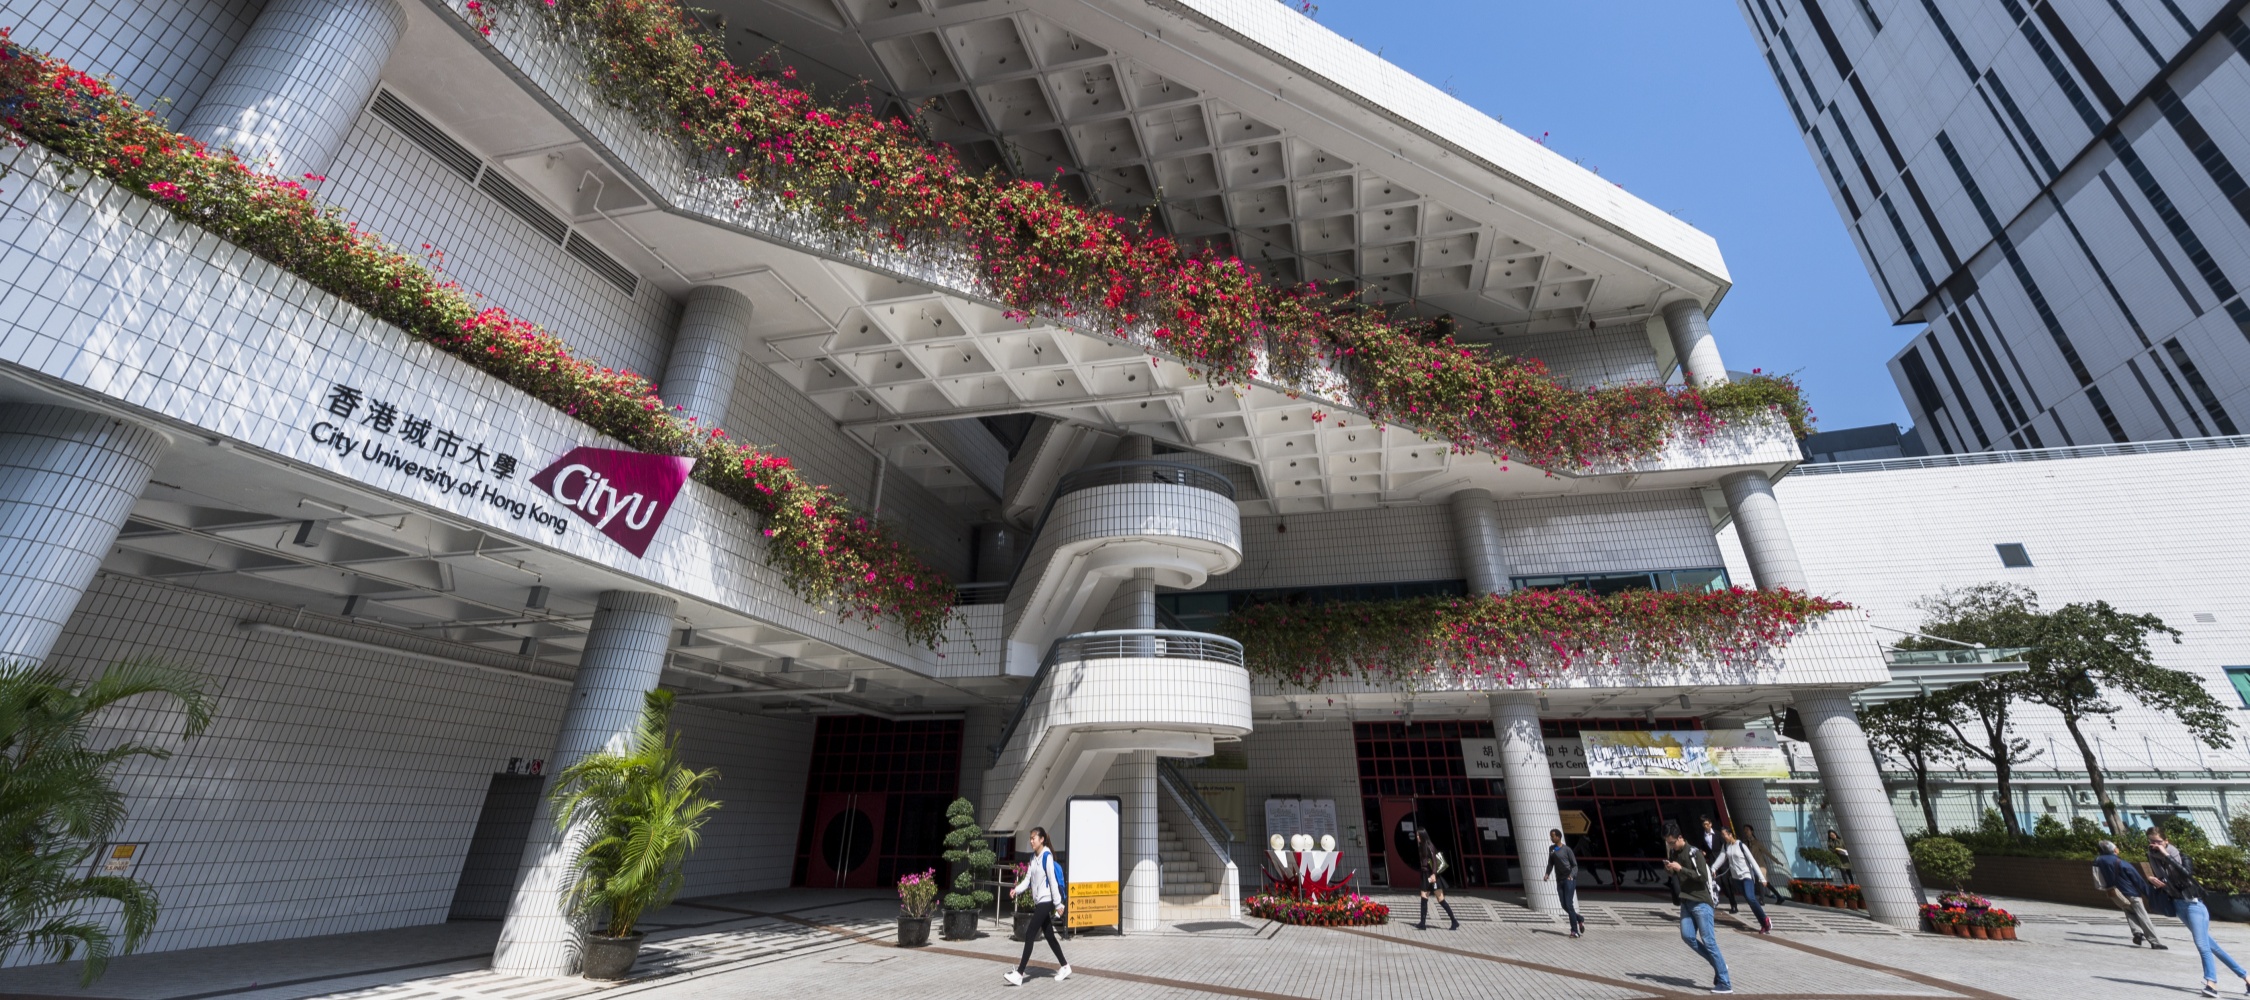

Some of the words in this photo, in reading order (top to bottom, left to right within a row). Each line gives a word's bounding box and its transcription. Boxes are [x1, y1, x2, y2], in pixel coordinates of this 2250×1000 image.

[328, 383, 517, 481] 香港城市大學
[310, 421, 359, 460] City
[361, 438, 459, 495] University
[459, 479, 483, 498] of
[481, 487, 527, 520] Hong
[528, 505, 568, 534] Kong
[552, 463, 658, 531] CityU
[1476, 760, 1489, 769] Hu
[1491, 760, 1502, 769] Fa
[1566, 760, 1588, 769] Cent
[1641, 757, 1690, 773] WELLNESS
